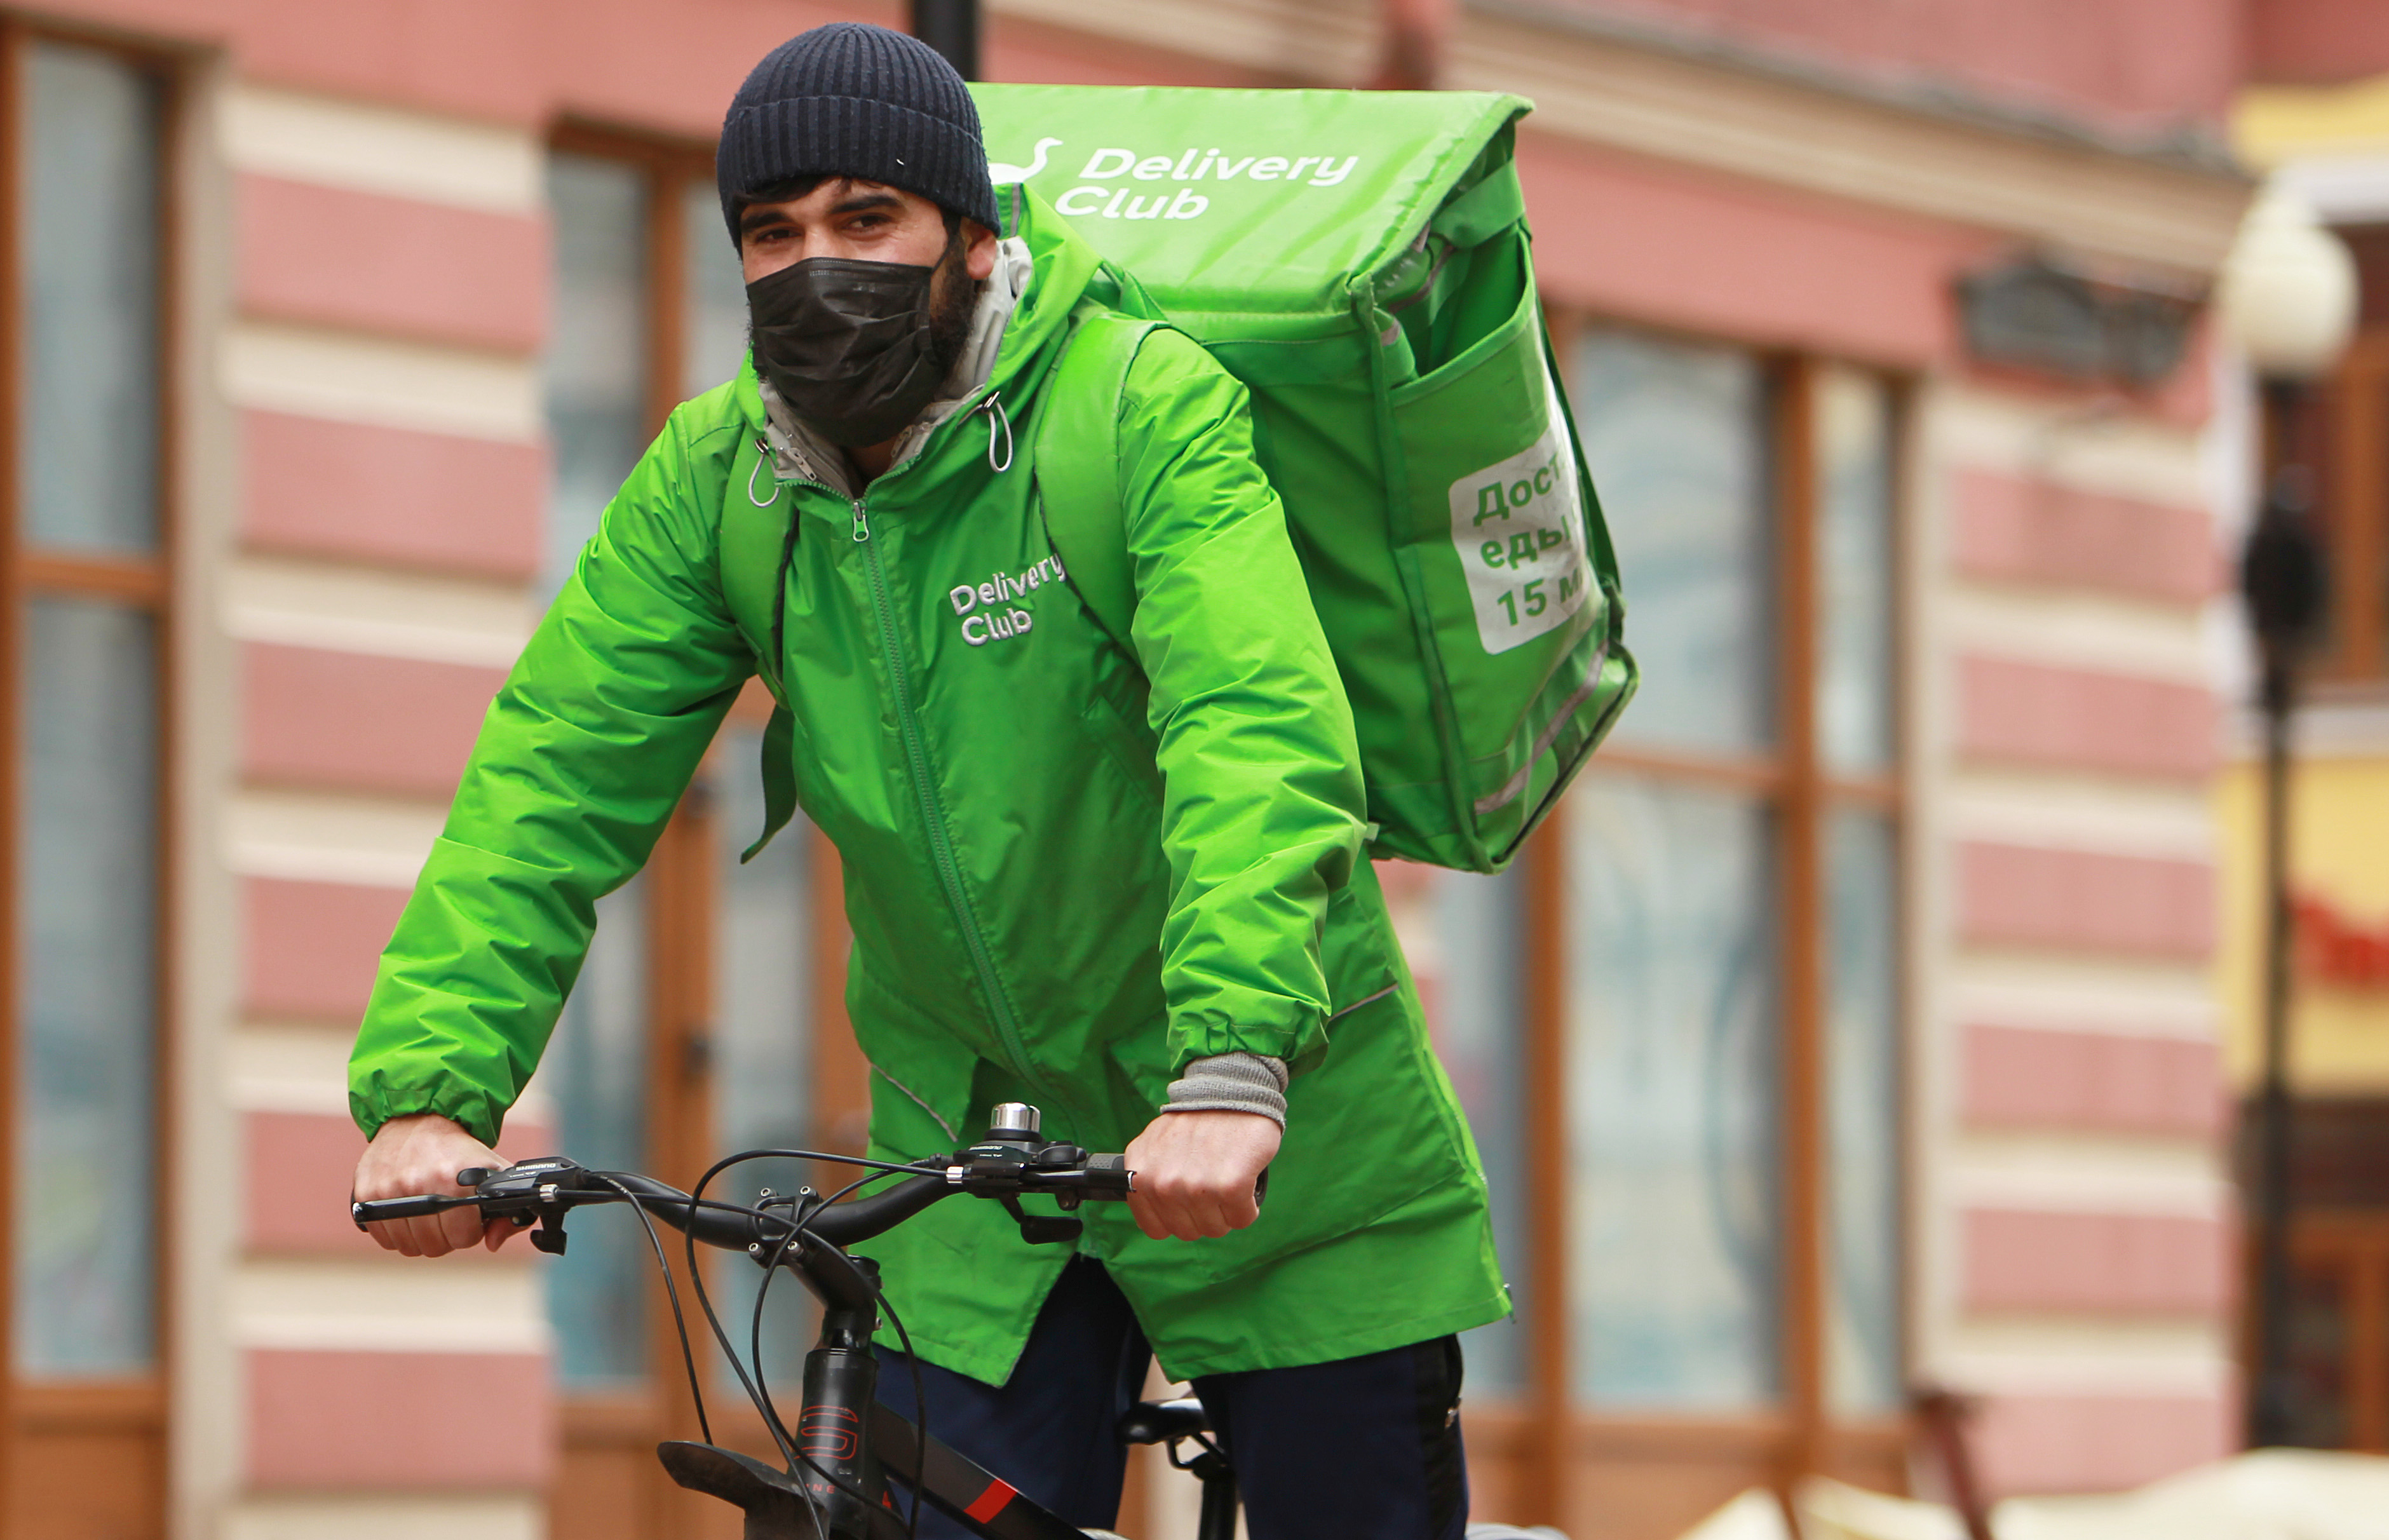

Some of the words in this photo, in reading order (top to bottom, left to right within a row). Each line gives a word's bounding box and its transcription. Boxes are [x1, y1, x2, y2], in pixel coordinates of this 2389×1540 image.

[1078, 147, 1358, 187] Delivery
[1054, 186, 1209, 220] Club
[1480, 515, 1571, 570] еды
[949, 553, 1067, 616] Delivery
[1497, 578, 1547, 627] 15
[1559, 568, 1582, 603] м
[961, 607, 1033, 647] Club
